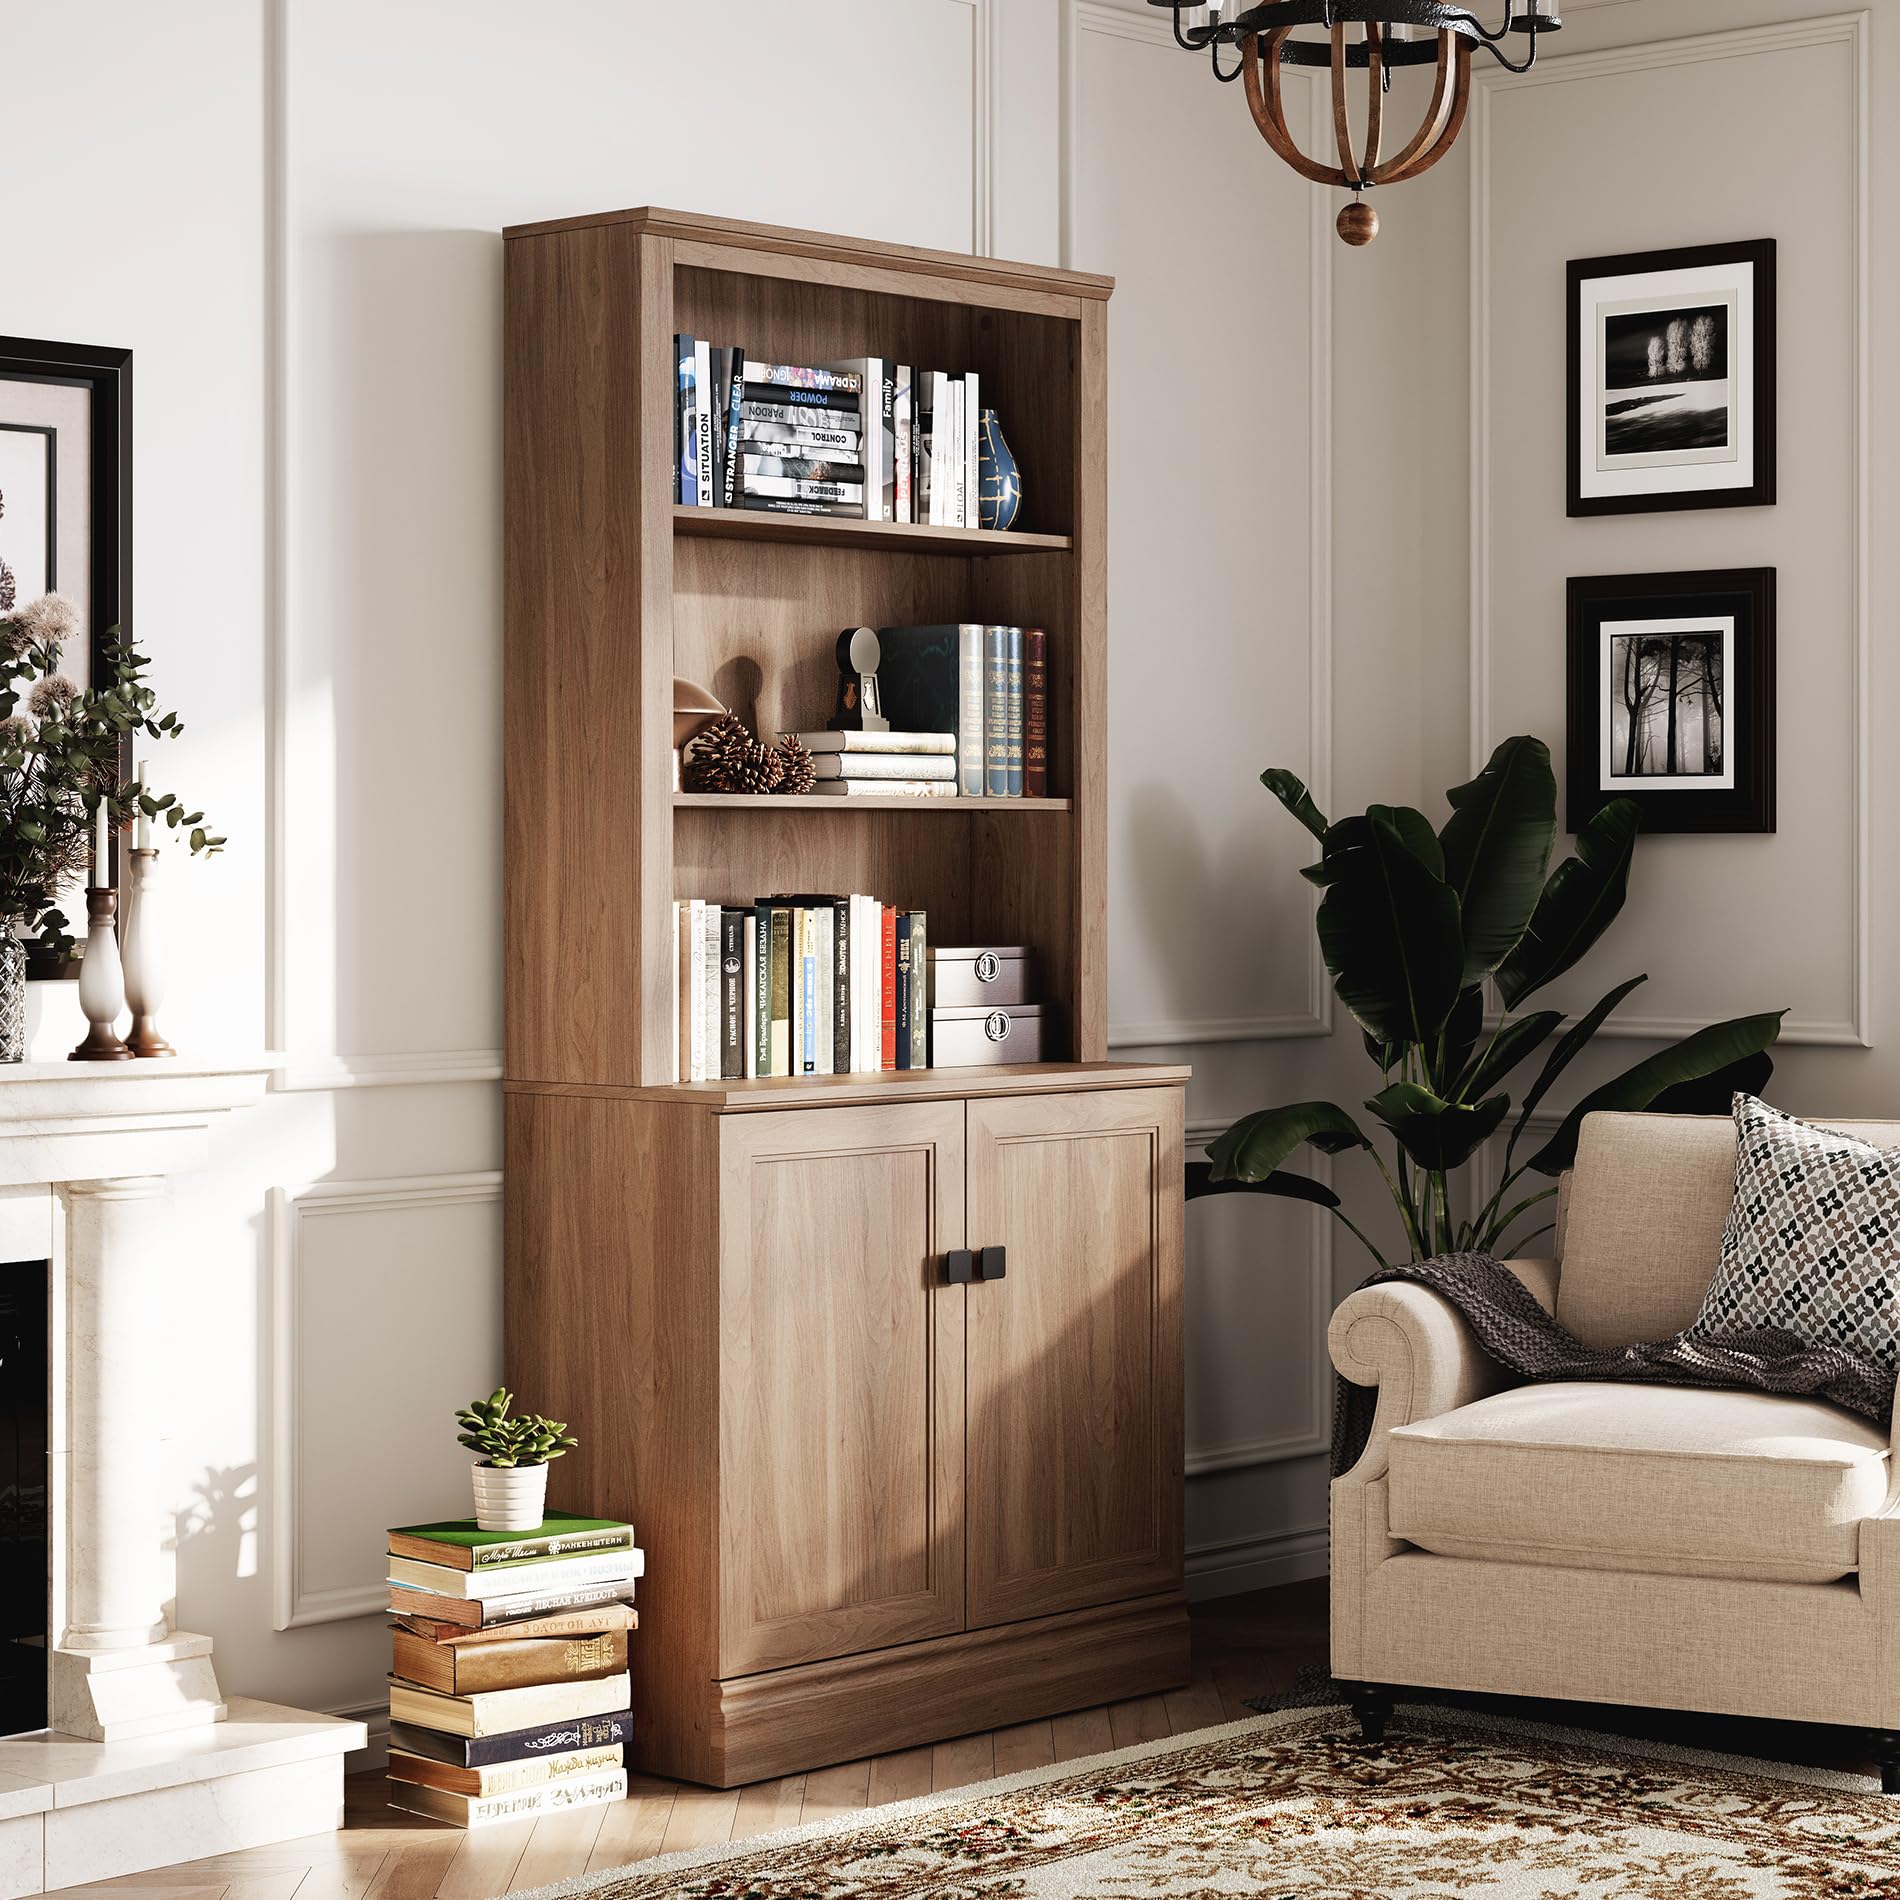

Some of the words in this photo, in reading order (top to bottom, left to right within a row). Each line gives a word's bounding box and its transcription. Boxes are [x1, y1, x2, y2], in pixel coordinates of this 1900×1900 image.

[731, 375, 743, 411] CLEAR
[814, 374, 848, 387] DRAMA
[789, 391, 828, 405] POWDER
[883, 378, 894, 418] Family
[748, 406, 784, 419] PARDON
[700, 413, 710, 482] SITUATION
[811, 432, 847, 444] CONTROL
[724, 425, 739, 492] STRANGER
[808, 485, 845, 497] FEEDBACK
[956, 480, 964, 513] FLOAT
[759, 920, 768, 954] БЕЗДНА
[759, 956, 767, 1009] ЧИКАГСКАЯ
[729, 1014, 737, 1046] КРАСНОЕ
[534, 1595, 572, 1611] ЛЕСНАЯ
[573, 1588, 618, 1604] КРЕПОСТЬ
[523, 1619, 584, 1634] ЗОЛОТОЙ
[588, 1616, 612, 1628] ЛУГ
[548, 1757, 584, 1779] Жажда
[585, 1754, 618, 1770] жизни
